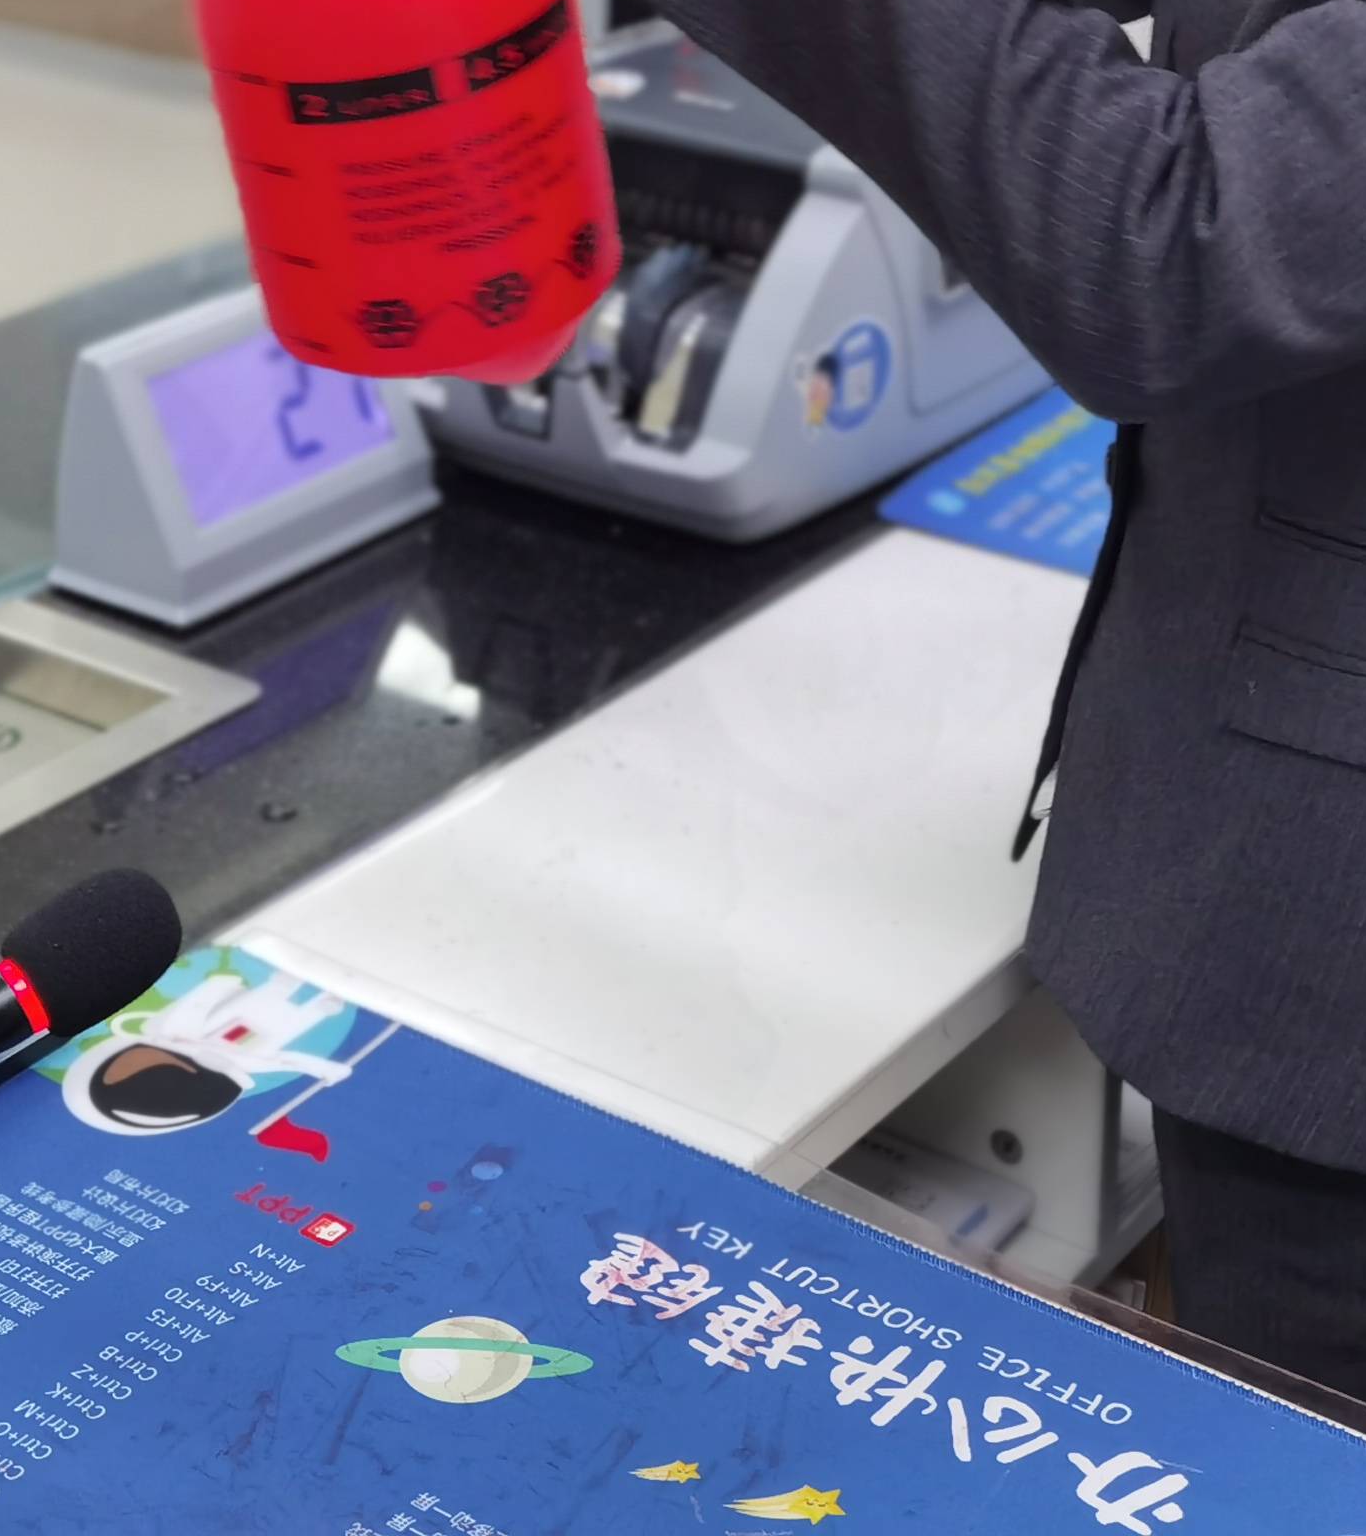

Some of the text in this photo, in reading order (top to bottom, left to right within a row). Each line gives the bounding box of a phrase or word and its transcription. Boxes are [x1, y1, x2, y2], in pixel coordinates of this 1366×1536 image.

[104, 1168, 305, 1272] Alt+N 幻灯片布局
[236, 1182, 313, 1225] PPT
[82, 1186, 282, 1290] Alt+S 幻灯片设计
[165, 1288, 235, 1324] Alt+F10
[196, 1275, 259, 1307] Alt+F9
[146, 1309, 210, 1343] Alt+F5
[677, 1221, 1134, 1426] OFFICE SHORTCUT KEY
[99, 1346, 157, 1380] Ctrl+B
[125, 1331, 182, 1362] Ctrl+P
[71, 1364, 132, 1399] Ctrl+Z
[579, 1232, 1189, 1536] 办公快捷键
[45, 1382, 106, 1419] Ctrl+K
[14, 1400, 79, 1439] Ctrl+M
